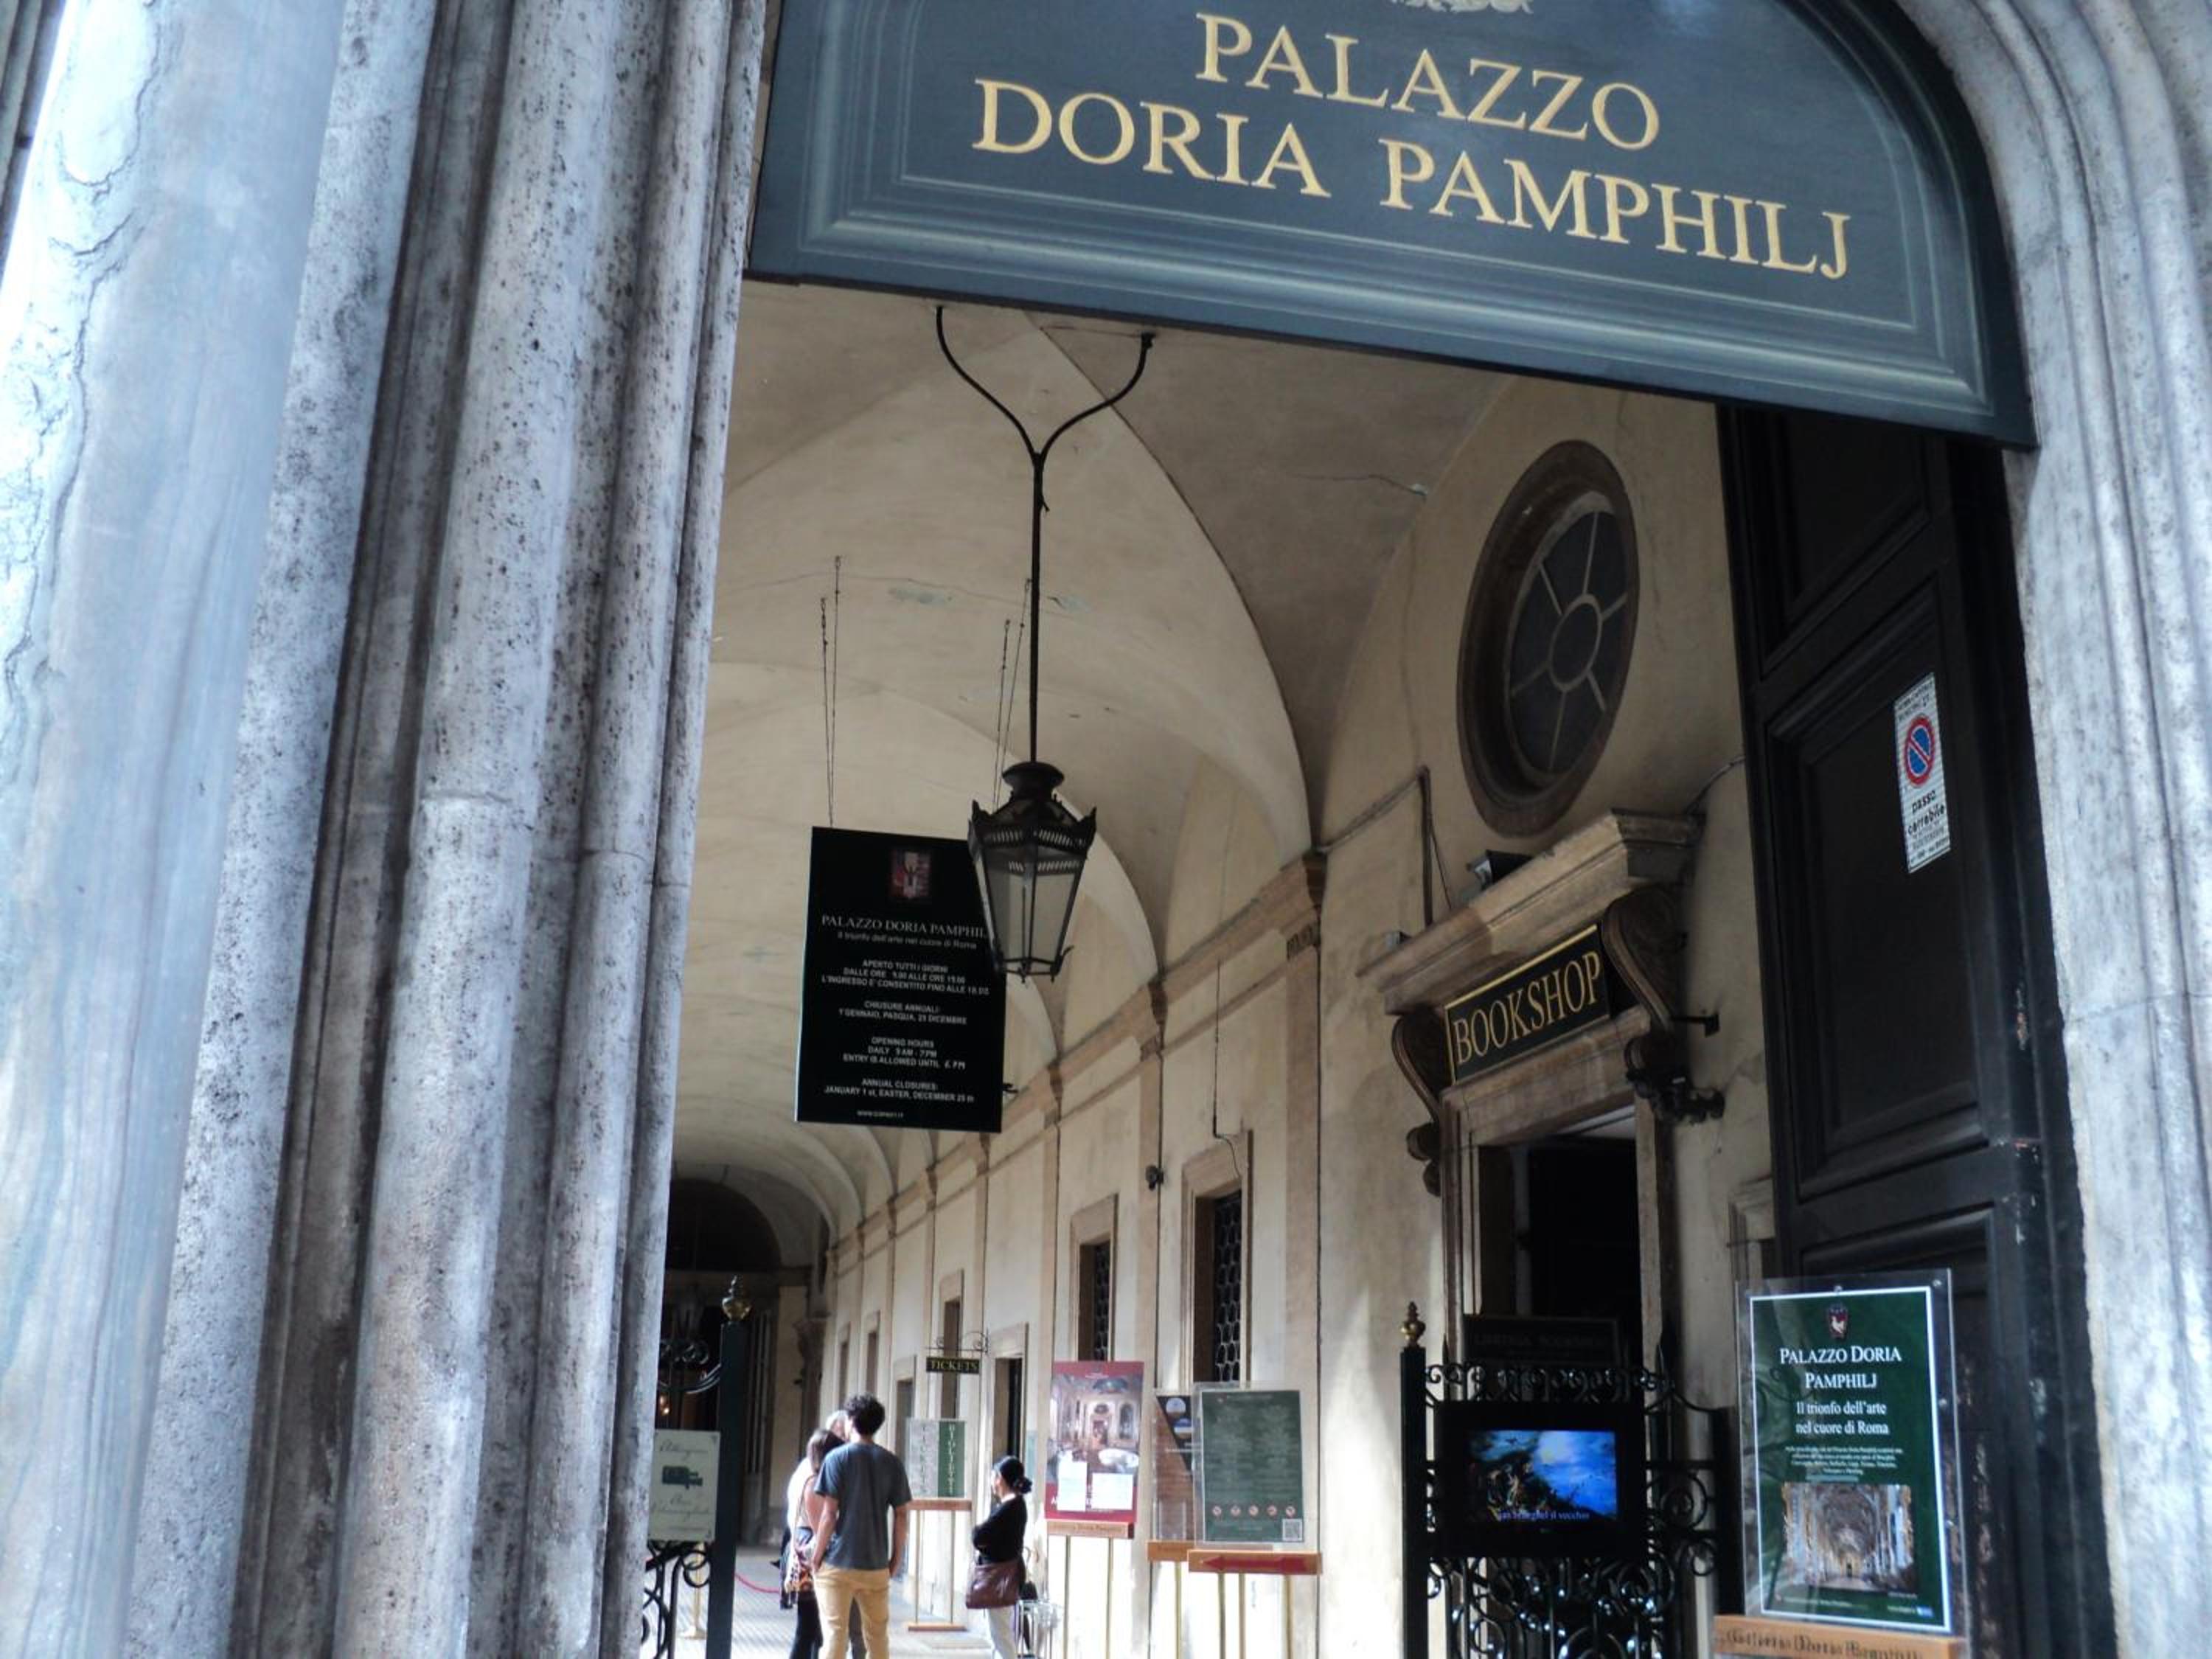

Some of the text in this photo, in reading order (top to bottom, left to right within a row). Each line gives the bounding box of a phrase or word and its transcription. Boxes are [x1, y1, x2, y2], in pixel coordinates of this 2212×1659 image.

[1194, 12, 1660, 151] PALAZZO
[972, 77, 1852, 280] DORIA PAMPHILJ
[821, 914, 883, 931] PALAZZO
[885, 919, 928, 933] DORIA
[862, 959, 894, 970] APERTO
[843, 966, 869, 977] DALLE
[869, 969, 886, 978] ORE
[908, 972, 928, 982] ALLE
[928, 973, 945, 983] ORE
[927, 983, 945, 992] FINO
[946, 984, 966, 994] ALLE
[1453, 950, 1601, 1064] BOOKSHOP
[928, 1015, 967, 1025] DICEMBRE
[871, 1036, 934, 1048] OPENING HOURS
[867, 1044, 890, 1055] DAILY
[843, 1053, 869, 1062] ENTRY
[878, 1056, 917, 1066] ALLOWED
[861, 1077, 893, 1088] ANNUAL
[824, 1085, 860, 1096] JANUARY
[912, 1091, 956, 1102] DECEMBER
[1779, 1344, 1902, 1365] PALAZZO DORIA
[931, 1360, 978, 1371] TICKETS
[1805, 1372, 1877, 1389] PAMPHILJ
[1806, 1401, 1842, 1415] trionfo
[1795, 1420, 1889, 1435] nel cuore di Roma
